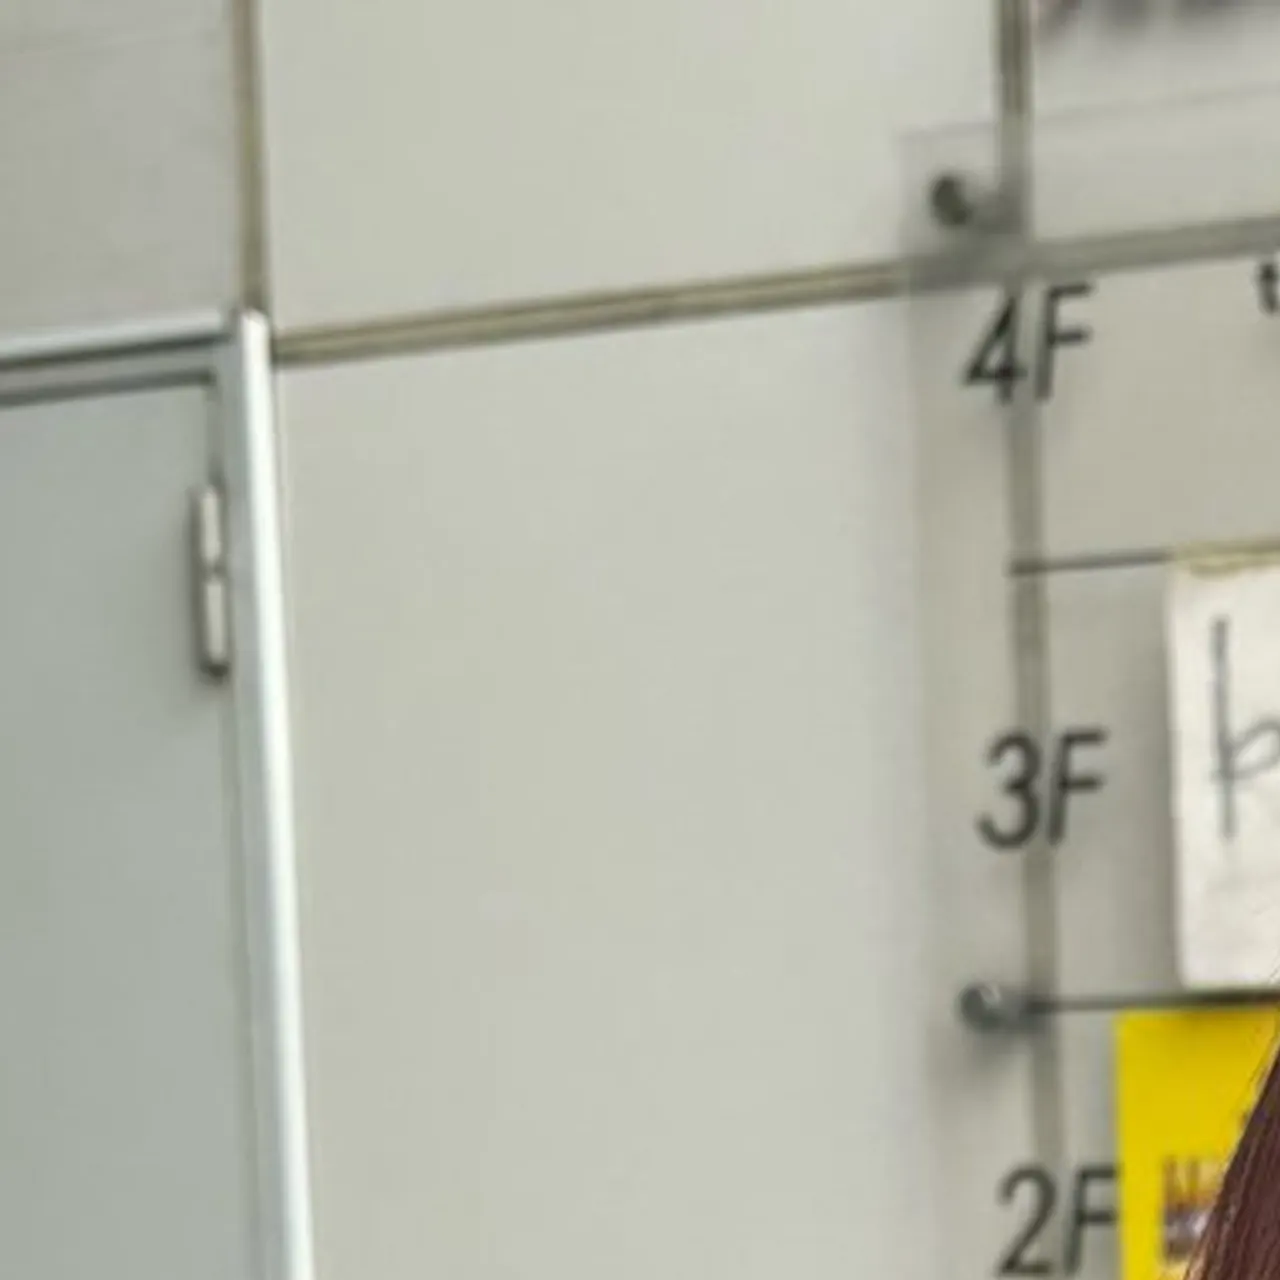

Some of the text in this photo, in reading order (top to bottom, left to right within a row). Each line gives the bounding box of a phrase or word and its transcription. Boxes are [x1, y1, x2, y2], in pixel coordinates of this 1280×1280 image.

[960, 283, 1096, 404] 4F
[976, 726, 1109, 851] 3F
[996, 1161, 1121, 1280] 2F
